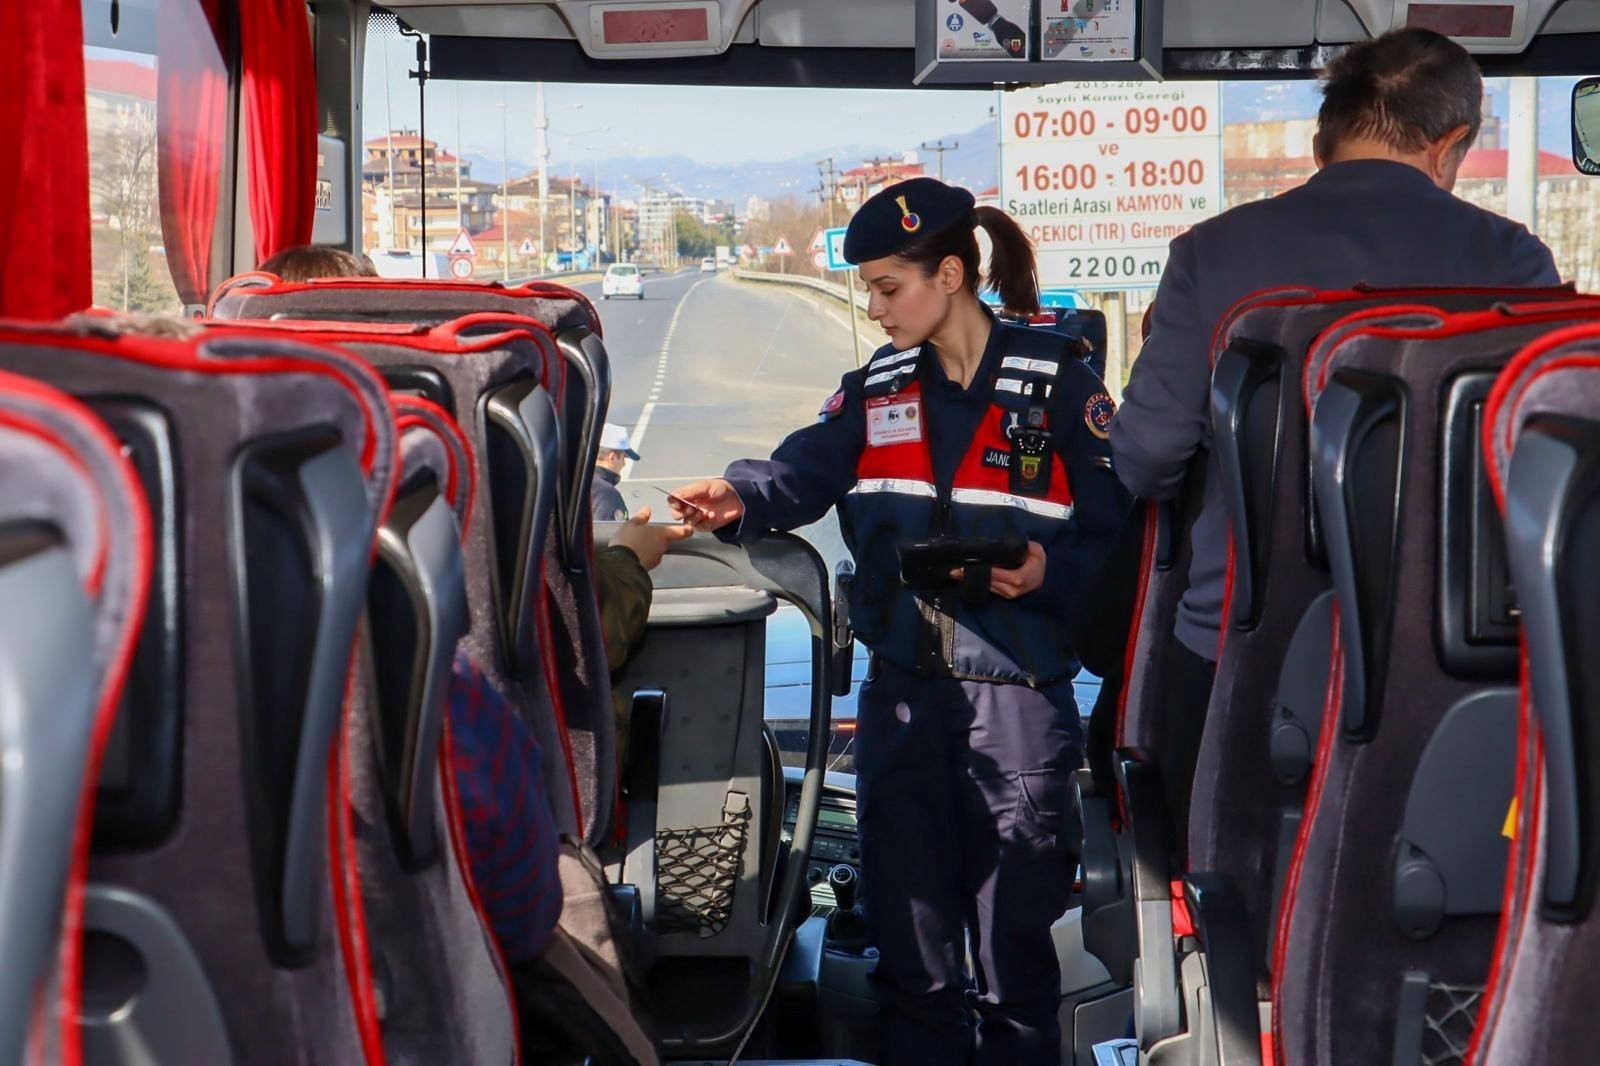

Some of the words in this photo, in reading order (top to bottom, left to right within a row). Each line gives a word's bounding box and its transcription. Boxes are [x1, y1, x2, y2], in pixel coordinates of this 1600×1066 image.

[1134, 91, 1185, 101] Gereği
[1014, 110, 1096, 138] 07:00
[1098, 143, 1120, 156] ve
[1016, 163, 1097, 191] 16:00
[1123, 159, 1205, 187] 18:00
[1008, 198, 1069, 216] Saatleri
[1072, 199, 1111, 214] Arası
[1116, 194, 1183, 212] KAMYON
[1189, 197, 1206, 210] ve
[1089, 222, 1125, 244] (TIR)
